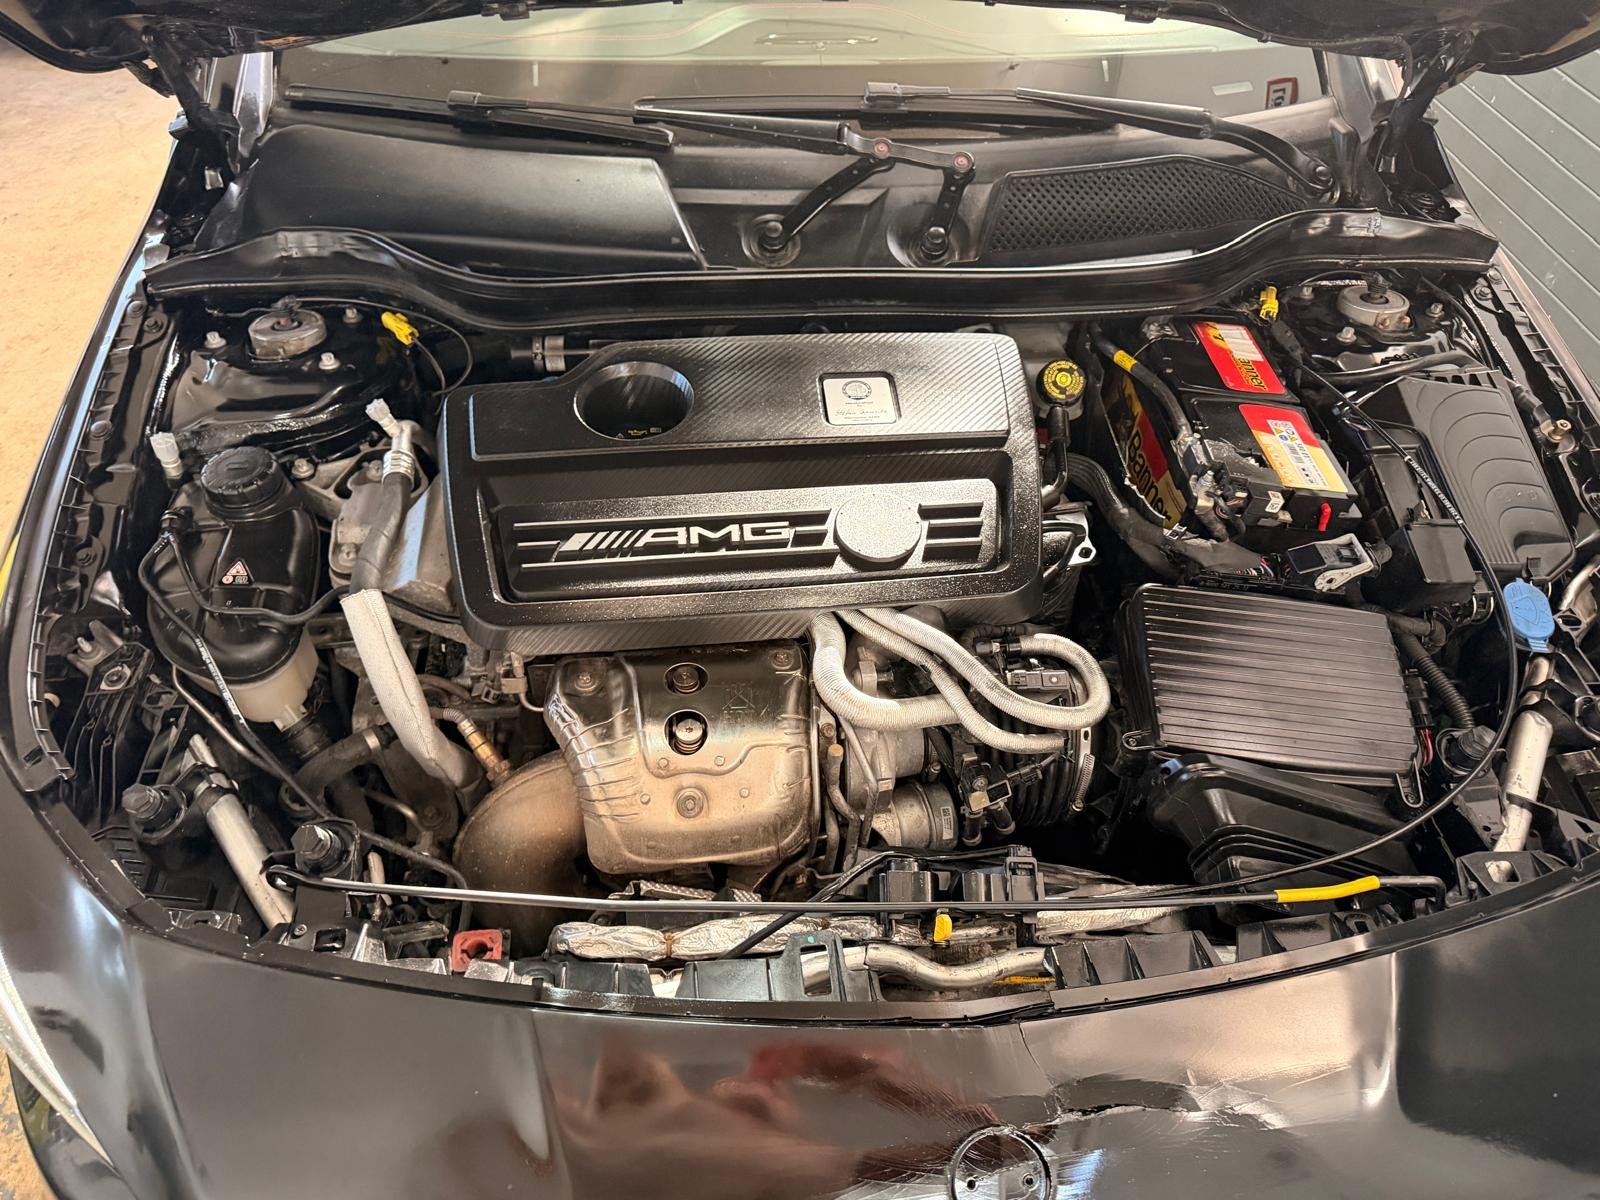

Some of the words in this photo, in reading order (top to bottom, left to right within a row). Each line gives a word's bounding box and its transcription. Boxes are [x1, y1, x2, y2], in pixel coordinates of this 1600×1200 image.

[1239, 357, 1266, 390] anner
[1128, 431, 1172, 521] Banner
[634, 521, 791, 548] AMG
